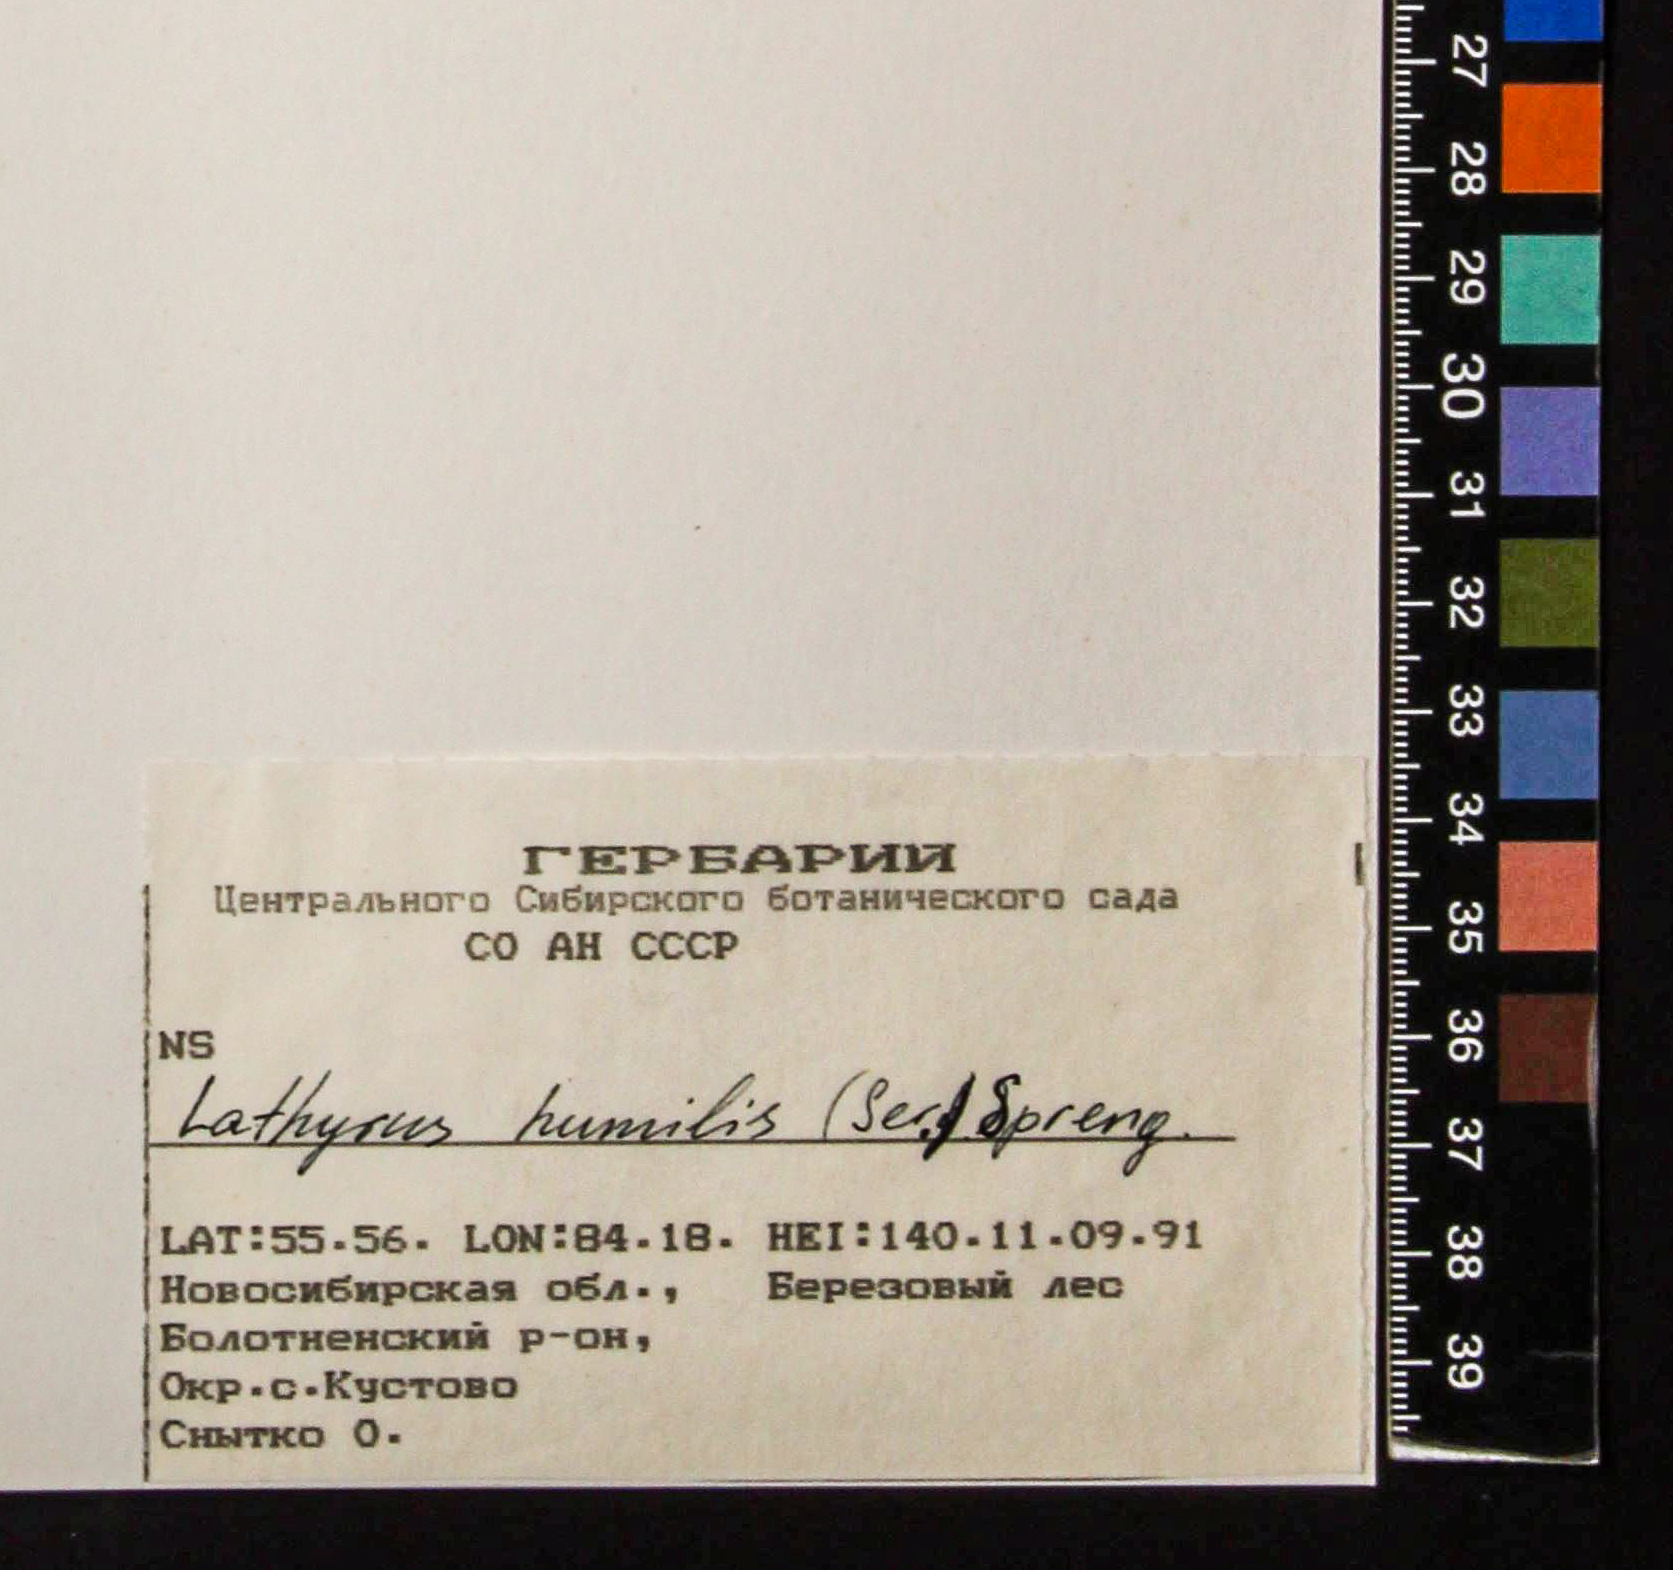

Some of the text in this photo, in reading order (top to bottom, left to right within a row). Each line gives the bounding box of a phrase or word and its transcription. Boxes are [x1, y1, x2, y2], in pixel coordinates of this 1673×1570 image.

[1452, 34, 1489, 88] 27
[1450, 141, 1487, 197] 28
[1449, 249, 1487, 305] 29
[1441, 352, 1486, 420] 30
[1450, 471, 1486, 518] 31
[1449, 576, 1485, 629] 32
[1449, 684, 1485, 738] 33
[1449, 792, 1485, 846] 34
[213, 883, 1180, 918] Центрального Сибирского ботанического сада
[463, 929, 740, 963] СО АН СССР
[1448, 901, 1484, 954] 35
[157, 1029, 216, 1061] NS
[1448, 1009, 1484, 1063] 36
[178, 1070, 453, 1176] Lathyrus
[516, 1072, 781, 1144] humilis
[1447, 1117, 1484, 1171] 37
[159, 1223, 430, 1257] LAT:55.56.
[463, 1221, 735, 1255] LON:84.18.
[1447, 1225, 1484, 1280] 38
[159, 1271, 679, 1308] Новосибирская обл.,
[766, 1268, 1125, 1305] Березовый лес
[158, 1320, 651, 1355] Болотненский р-он,
[1447, 1333, 1484, 1390] 39
[158, 1369, 519, 1406] Окр.с.Кустово
[158, 1418, 327, 1450] Снытко
